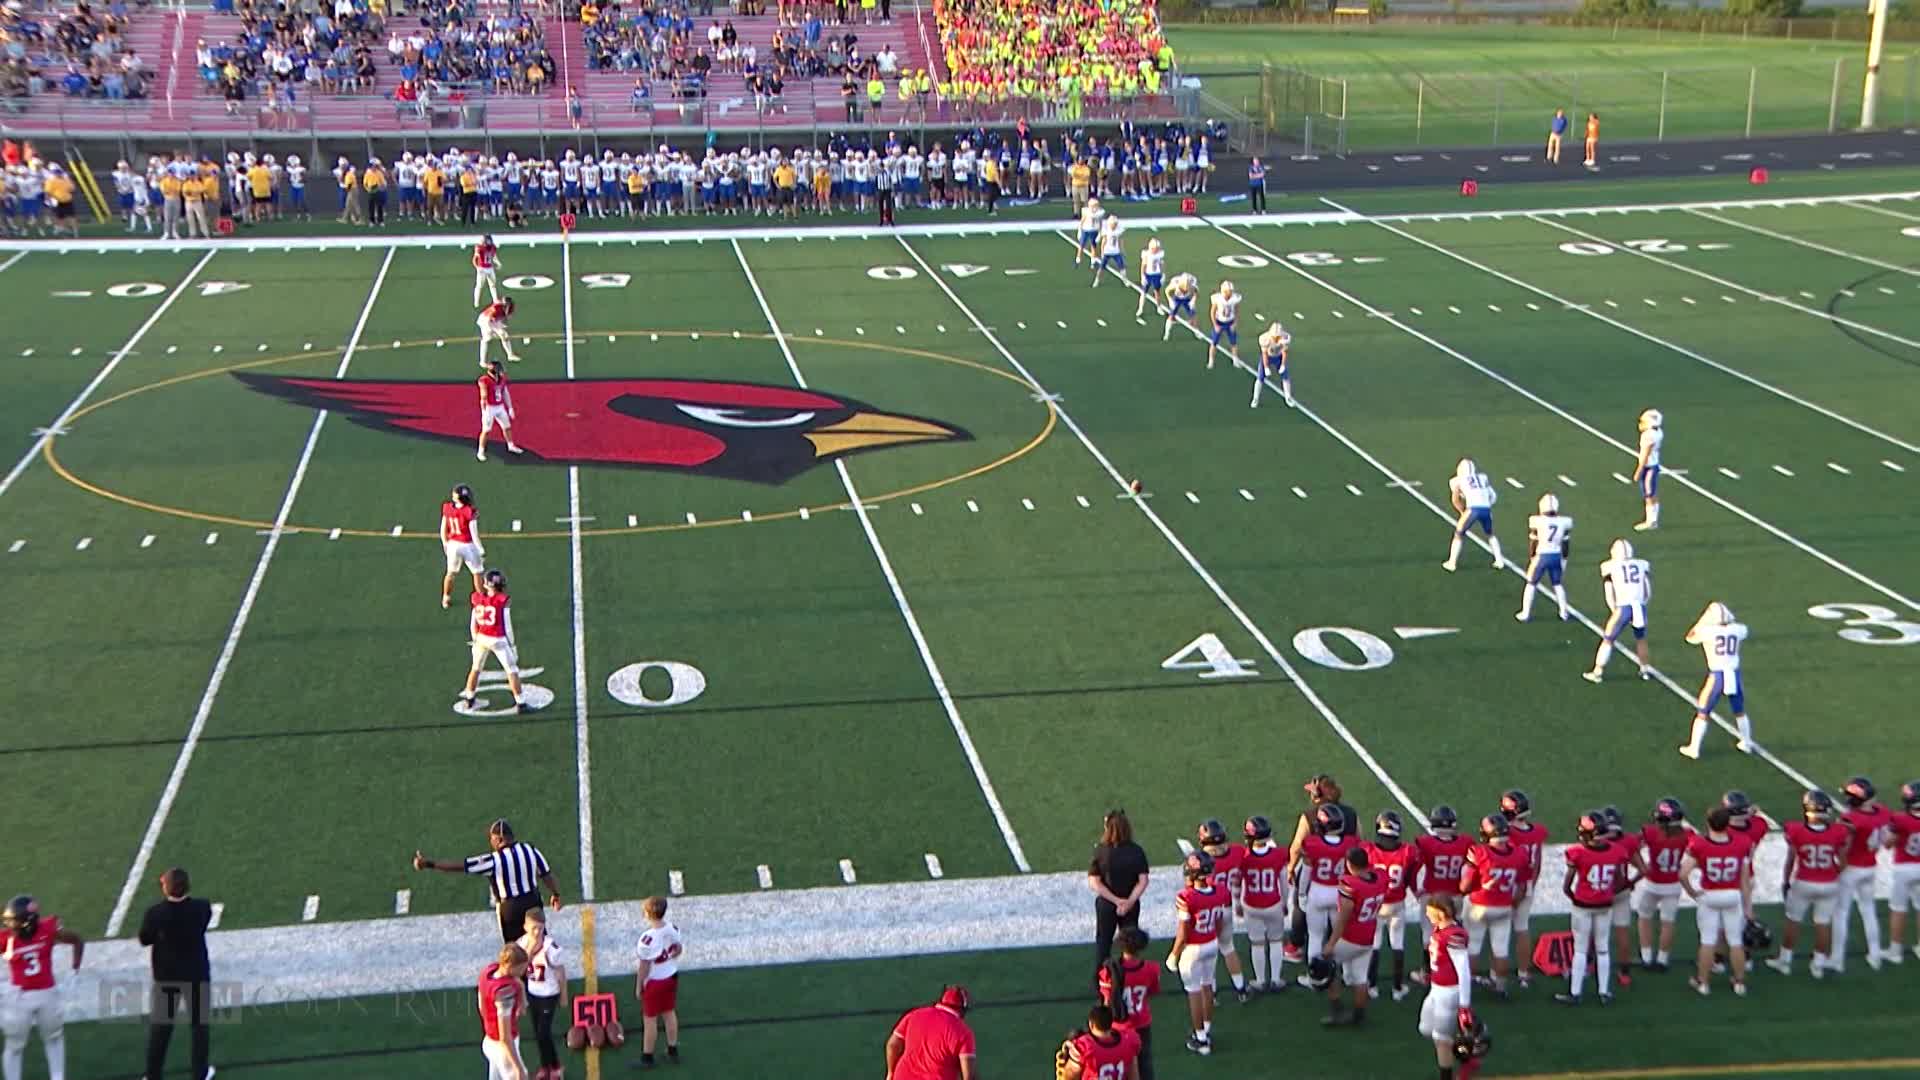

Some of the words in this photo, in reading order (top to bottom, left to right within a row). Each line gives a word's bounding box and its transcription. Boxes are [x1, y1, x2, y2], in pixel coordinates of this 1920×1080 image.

[449, 516, 462, 536] 11
[1548, 525, 1558, 543] 7
[1621, 563, 1641, 584] 12
[475, 605, 498, 627] 23
[1714, 633, 1738, 656] 20
[1433, 854, 1463, 879] 58
[1655, 847, 1682, 873] 41
[1705, 855, 1740, 882] 52
[1800, 843, 1835, 869] 35
[1246, 868, 1276, 893] 30
[1317, 857, 1346, 881] 24
[1586, 863, 1616, 890] 45
[23, 950, 41, 977] 3
[577, 999, 613, 1029] 50
